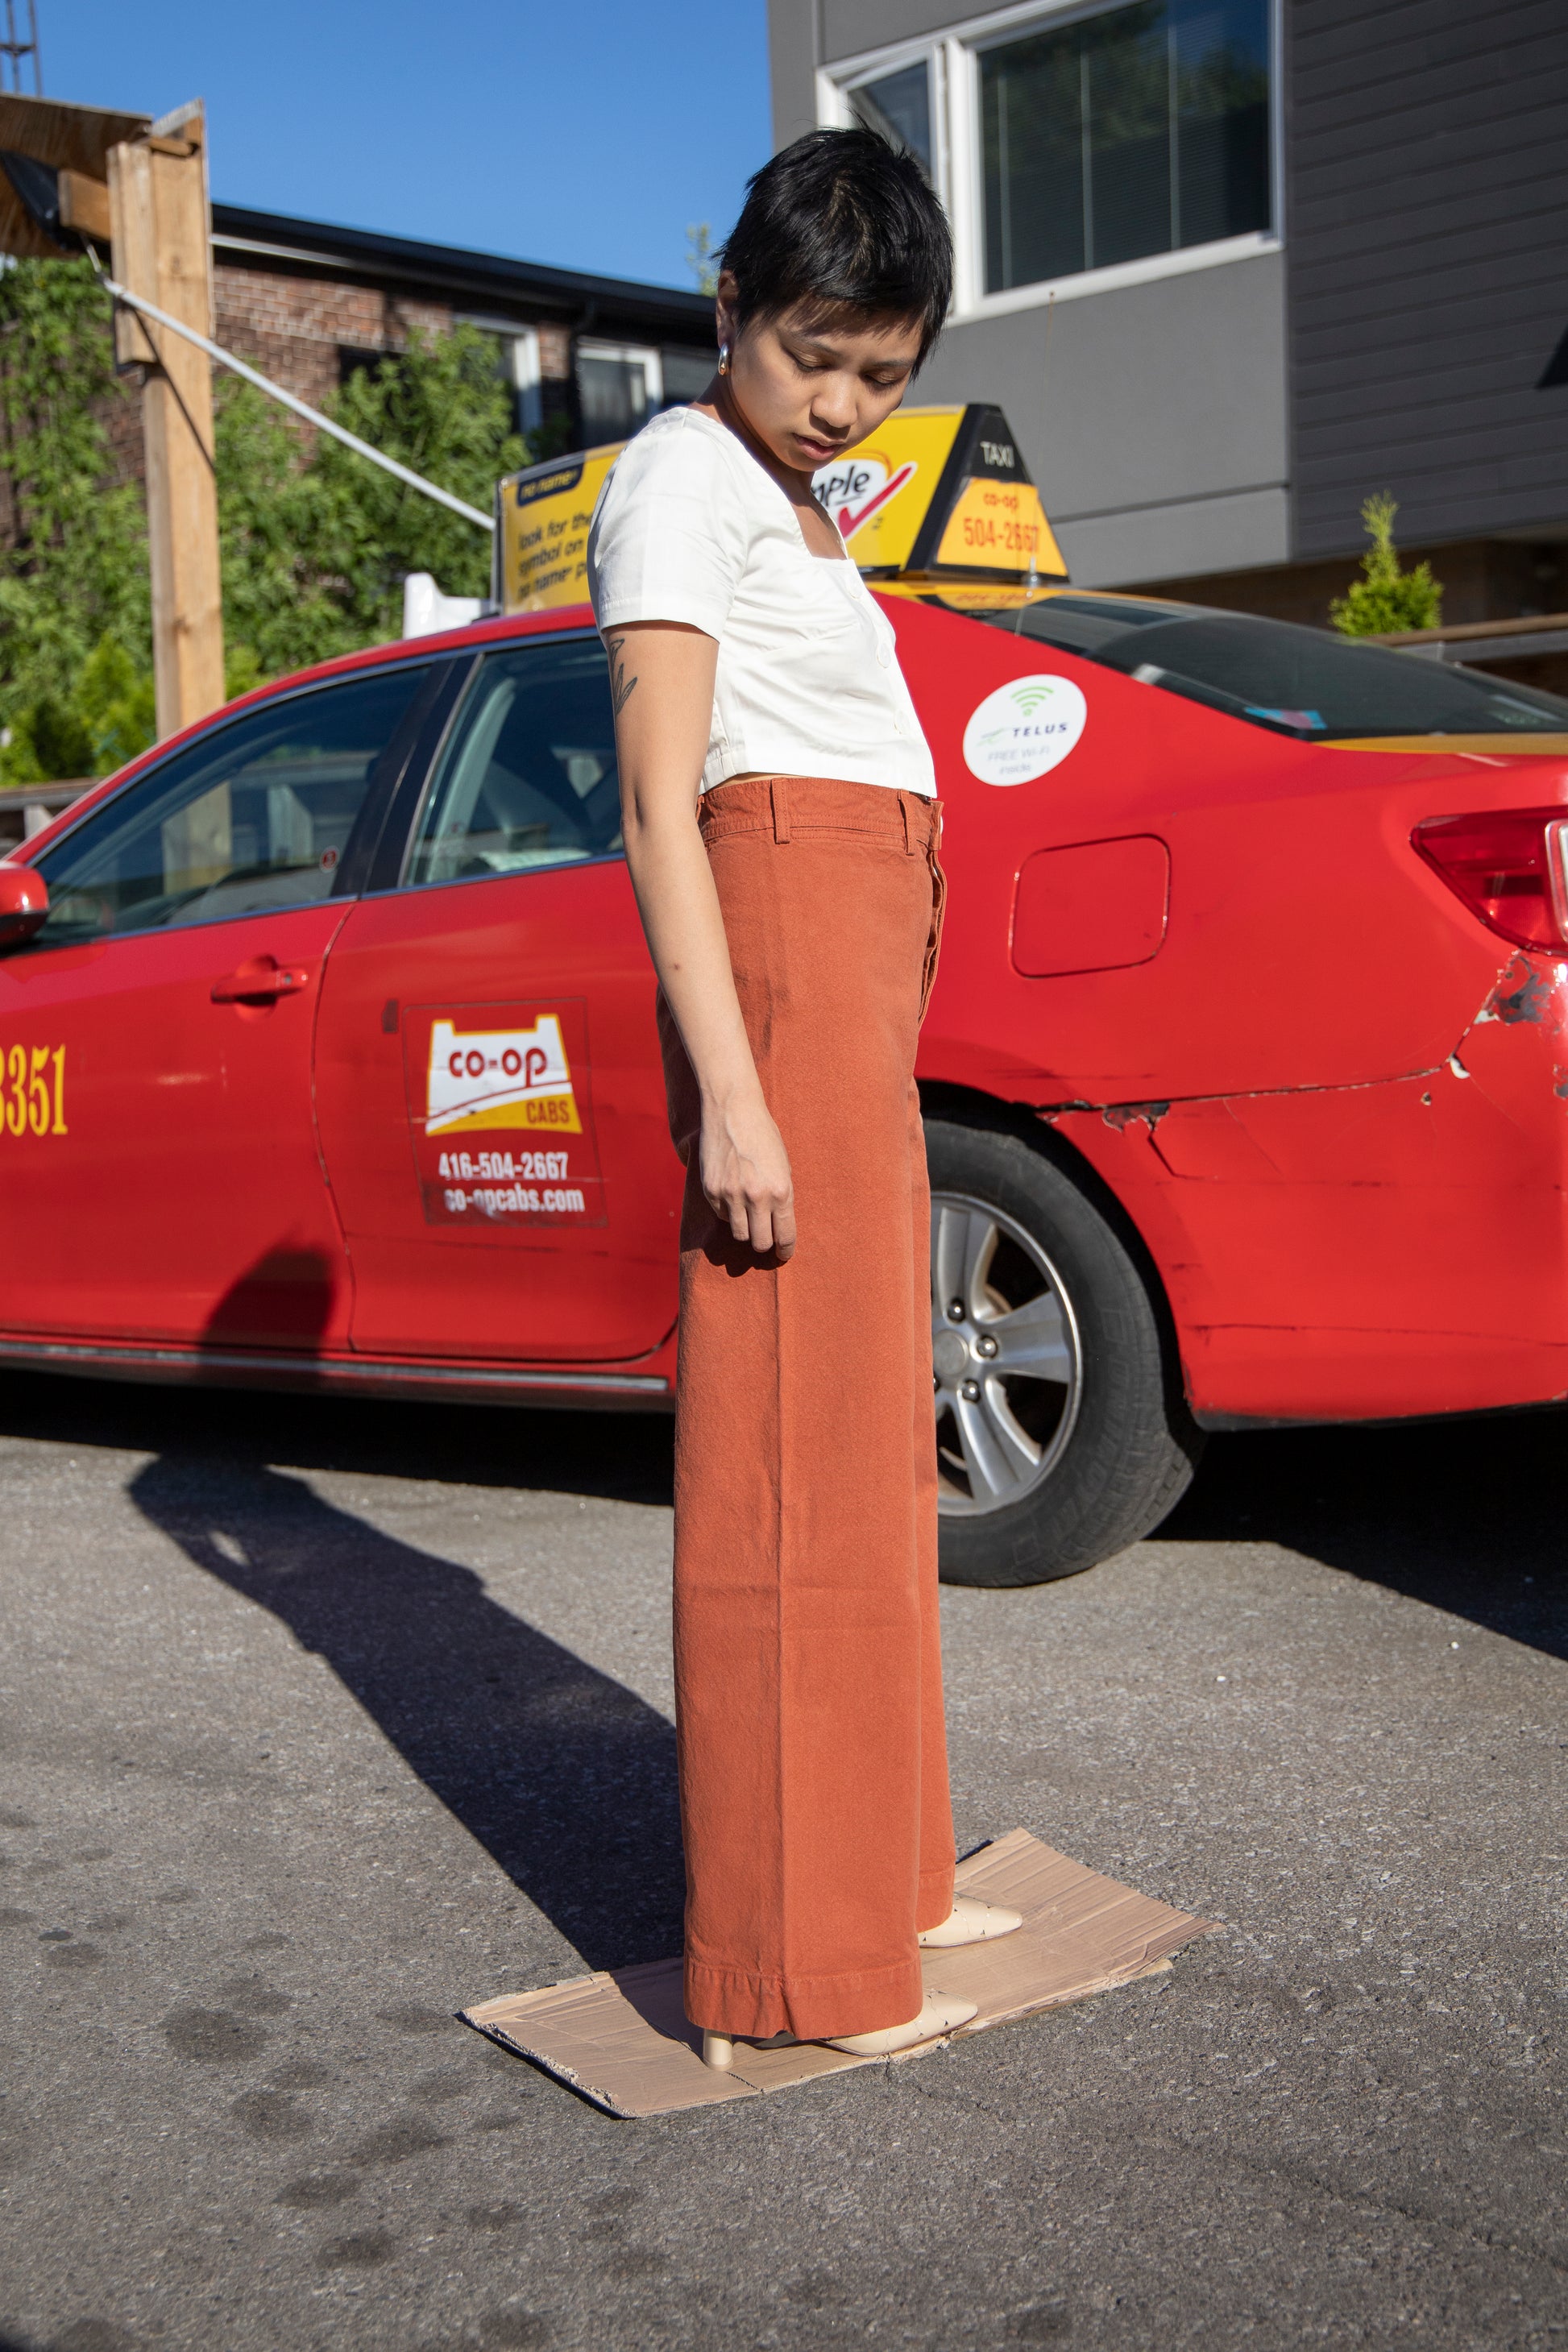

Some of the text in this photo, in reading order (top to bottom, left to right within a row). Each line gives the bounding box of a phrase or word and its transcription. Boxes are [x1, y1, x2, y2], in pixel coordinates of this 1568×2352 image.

[980, 441, 1015, 468] TAXI
[520, 471, 573, 500] no name
[983, 492, 1018, 513] co-op
[518, 526, 542, 551] look
[547, 518, 567, 540] for
[964, 517, 1039, 553] 504-2667
[518, 541, 562, 578] symbol
[565, 539, 584, 556] on
[517, 583, 531, 600] no
[1012, 722, 1069, 738] TELUS
[448, 1047, 548, 1088] co-op
[526, 1099, 570, 1124] CABS
[438, 1151, 569, 1180] 416-504-2667
[444, 1182, 586, 1213] co-opcabs.com
